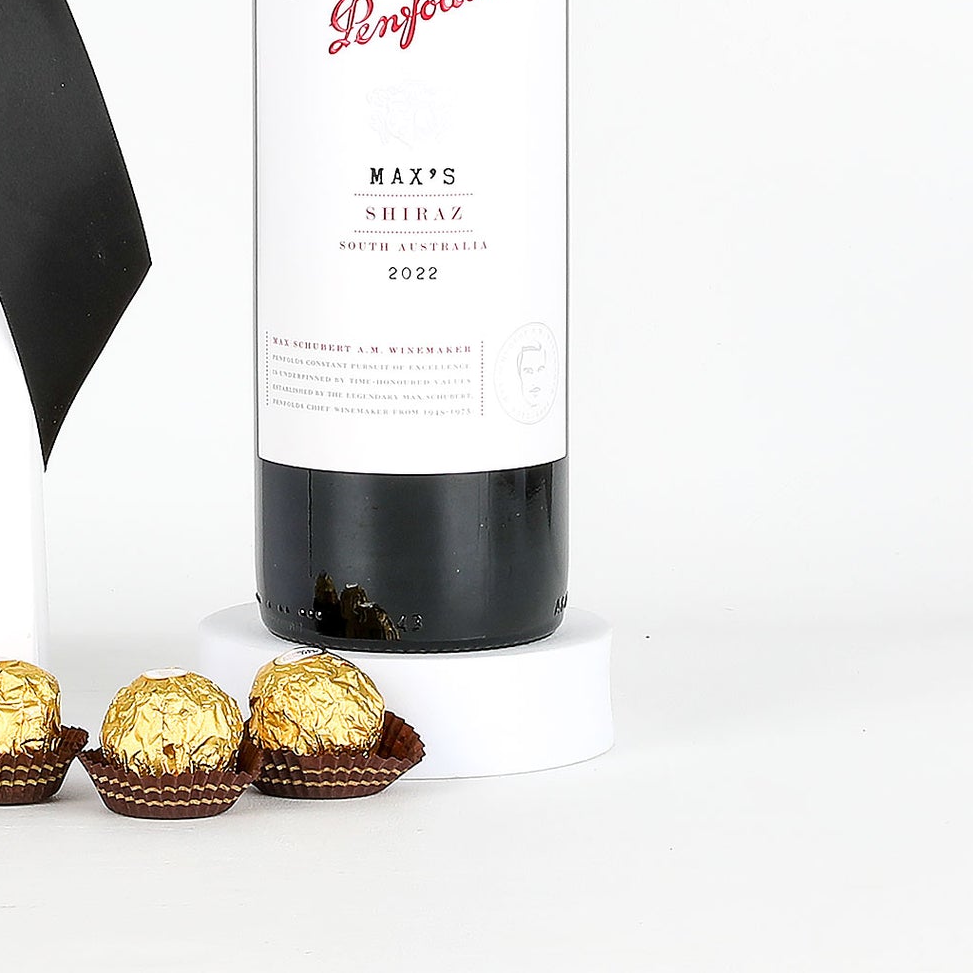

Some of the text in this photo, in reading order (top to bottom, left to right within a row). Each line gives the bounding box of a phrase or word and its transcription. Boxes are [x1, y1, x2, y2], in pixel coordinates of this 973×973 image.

[370, 167, 456, 185] MAX'S
[365, 206, 464, 221] SHIRAZ
[338, 240, 488, 252] SOUTH AUSTRALIA
[388, 266, 438, 280] 2022
[272, 336, 471, 354] MAX SCHUBERT A.M. WINEMAKER
[305, 359, 348, 369] CONSTANT
[279, 370, 332, 383] UNDERPINNED
[272, 383, 314, 395] ESTABLISHED
[306, 404, 330, 412] CHIEF
[334, 406, 388, 415] WINEMAKER
